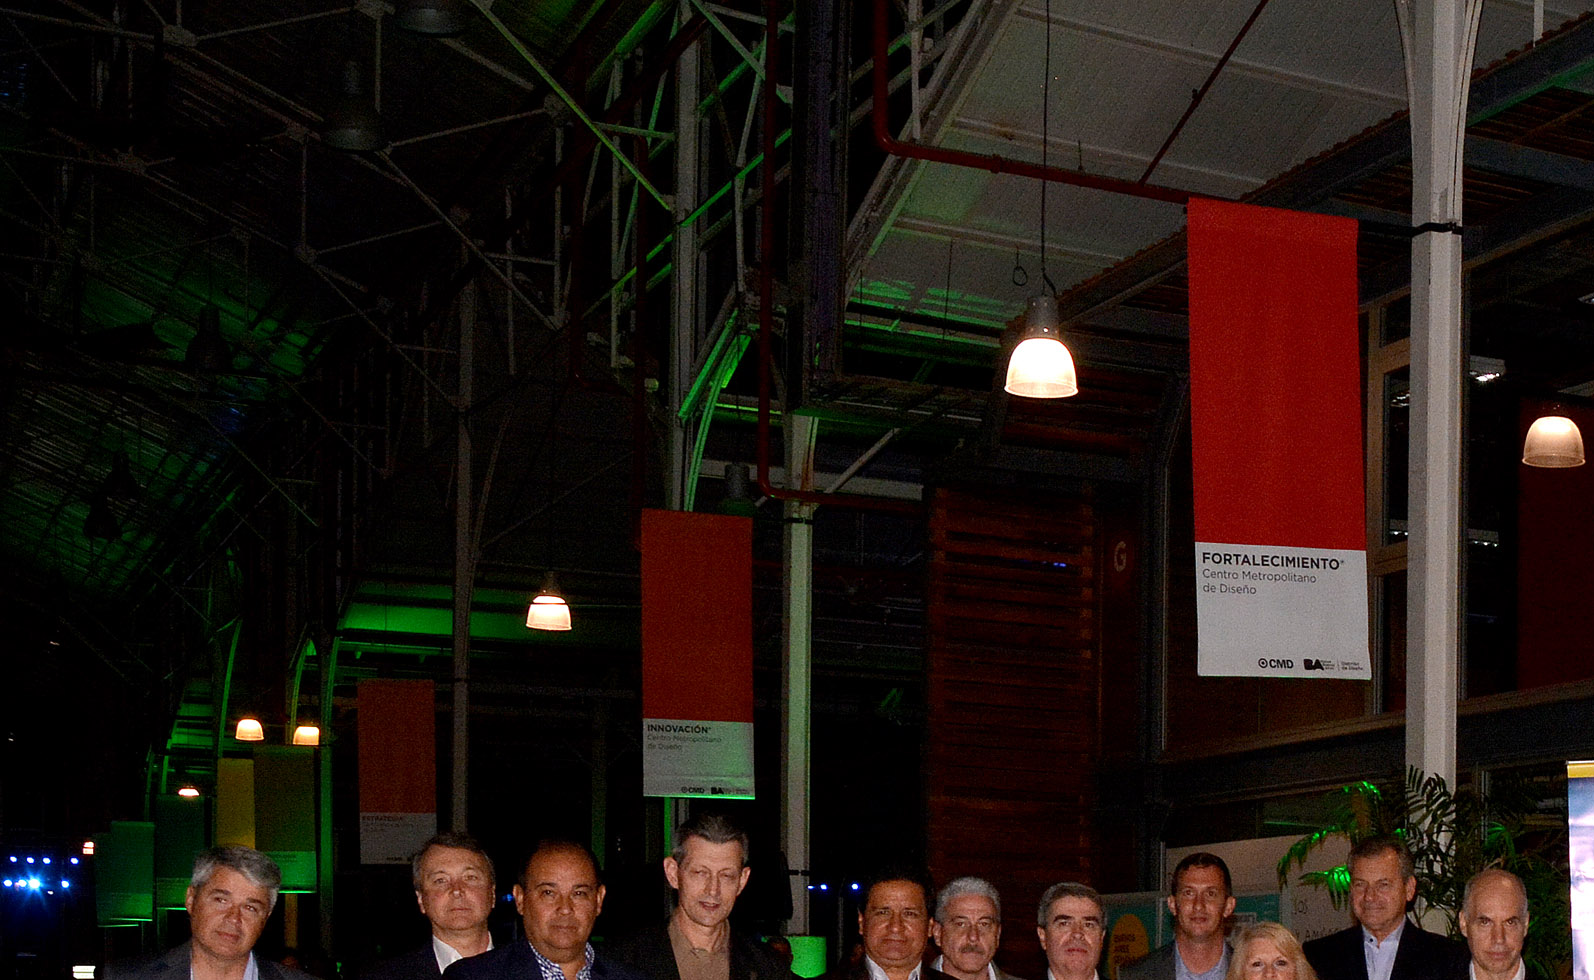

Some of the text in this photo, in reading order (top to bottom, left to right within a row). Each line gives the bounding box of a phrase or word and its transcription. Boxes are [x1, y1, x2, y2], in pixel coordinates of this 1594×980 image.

[1202, 552, 1340, 570] FORTALECIMIENTO
[1202, 568, 1317, 584] Centro Metropolitano
[1203, 583, 1257, 595] de Diseño
[1269, 659, 1294, 669] CMD
[647, 724, 709, 734] INNOVACIÓN
